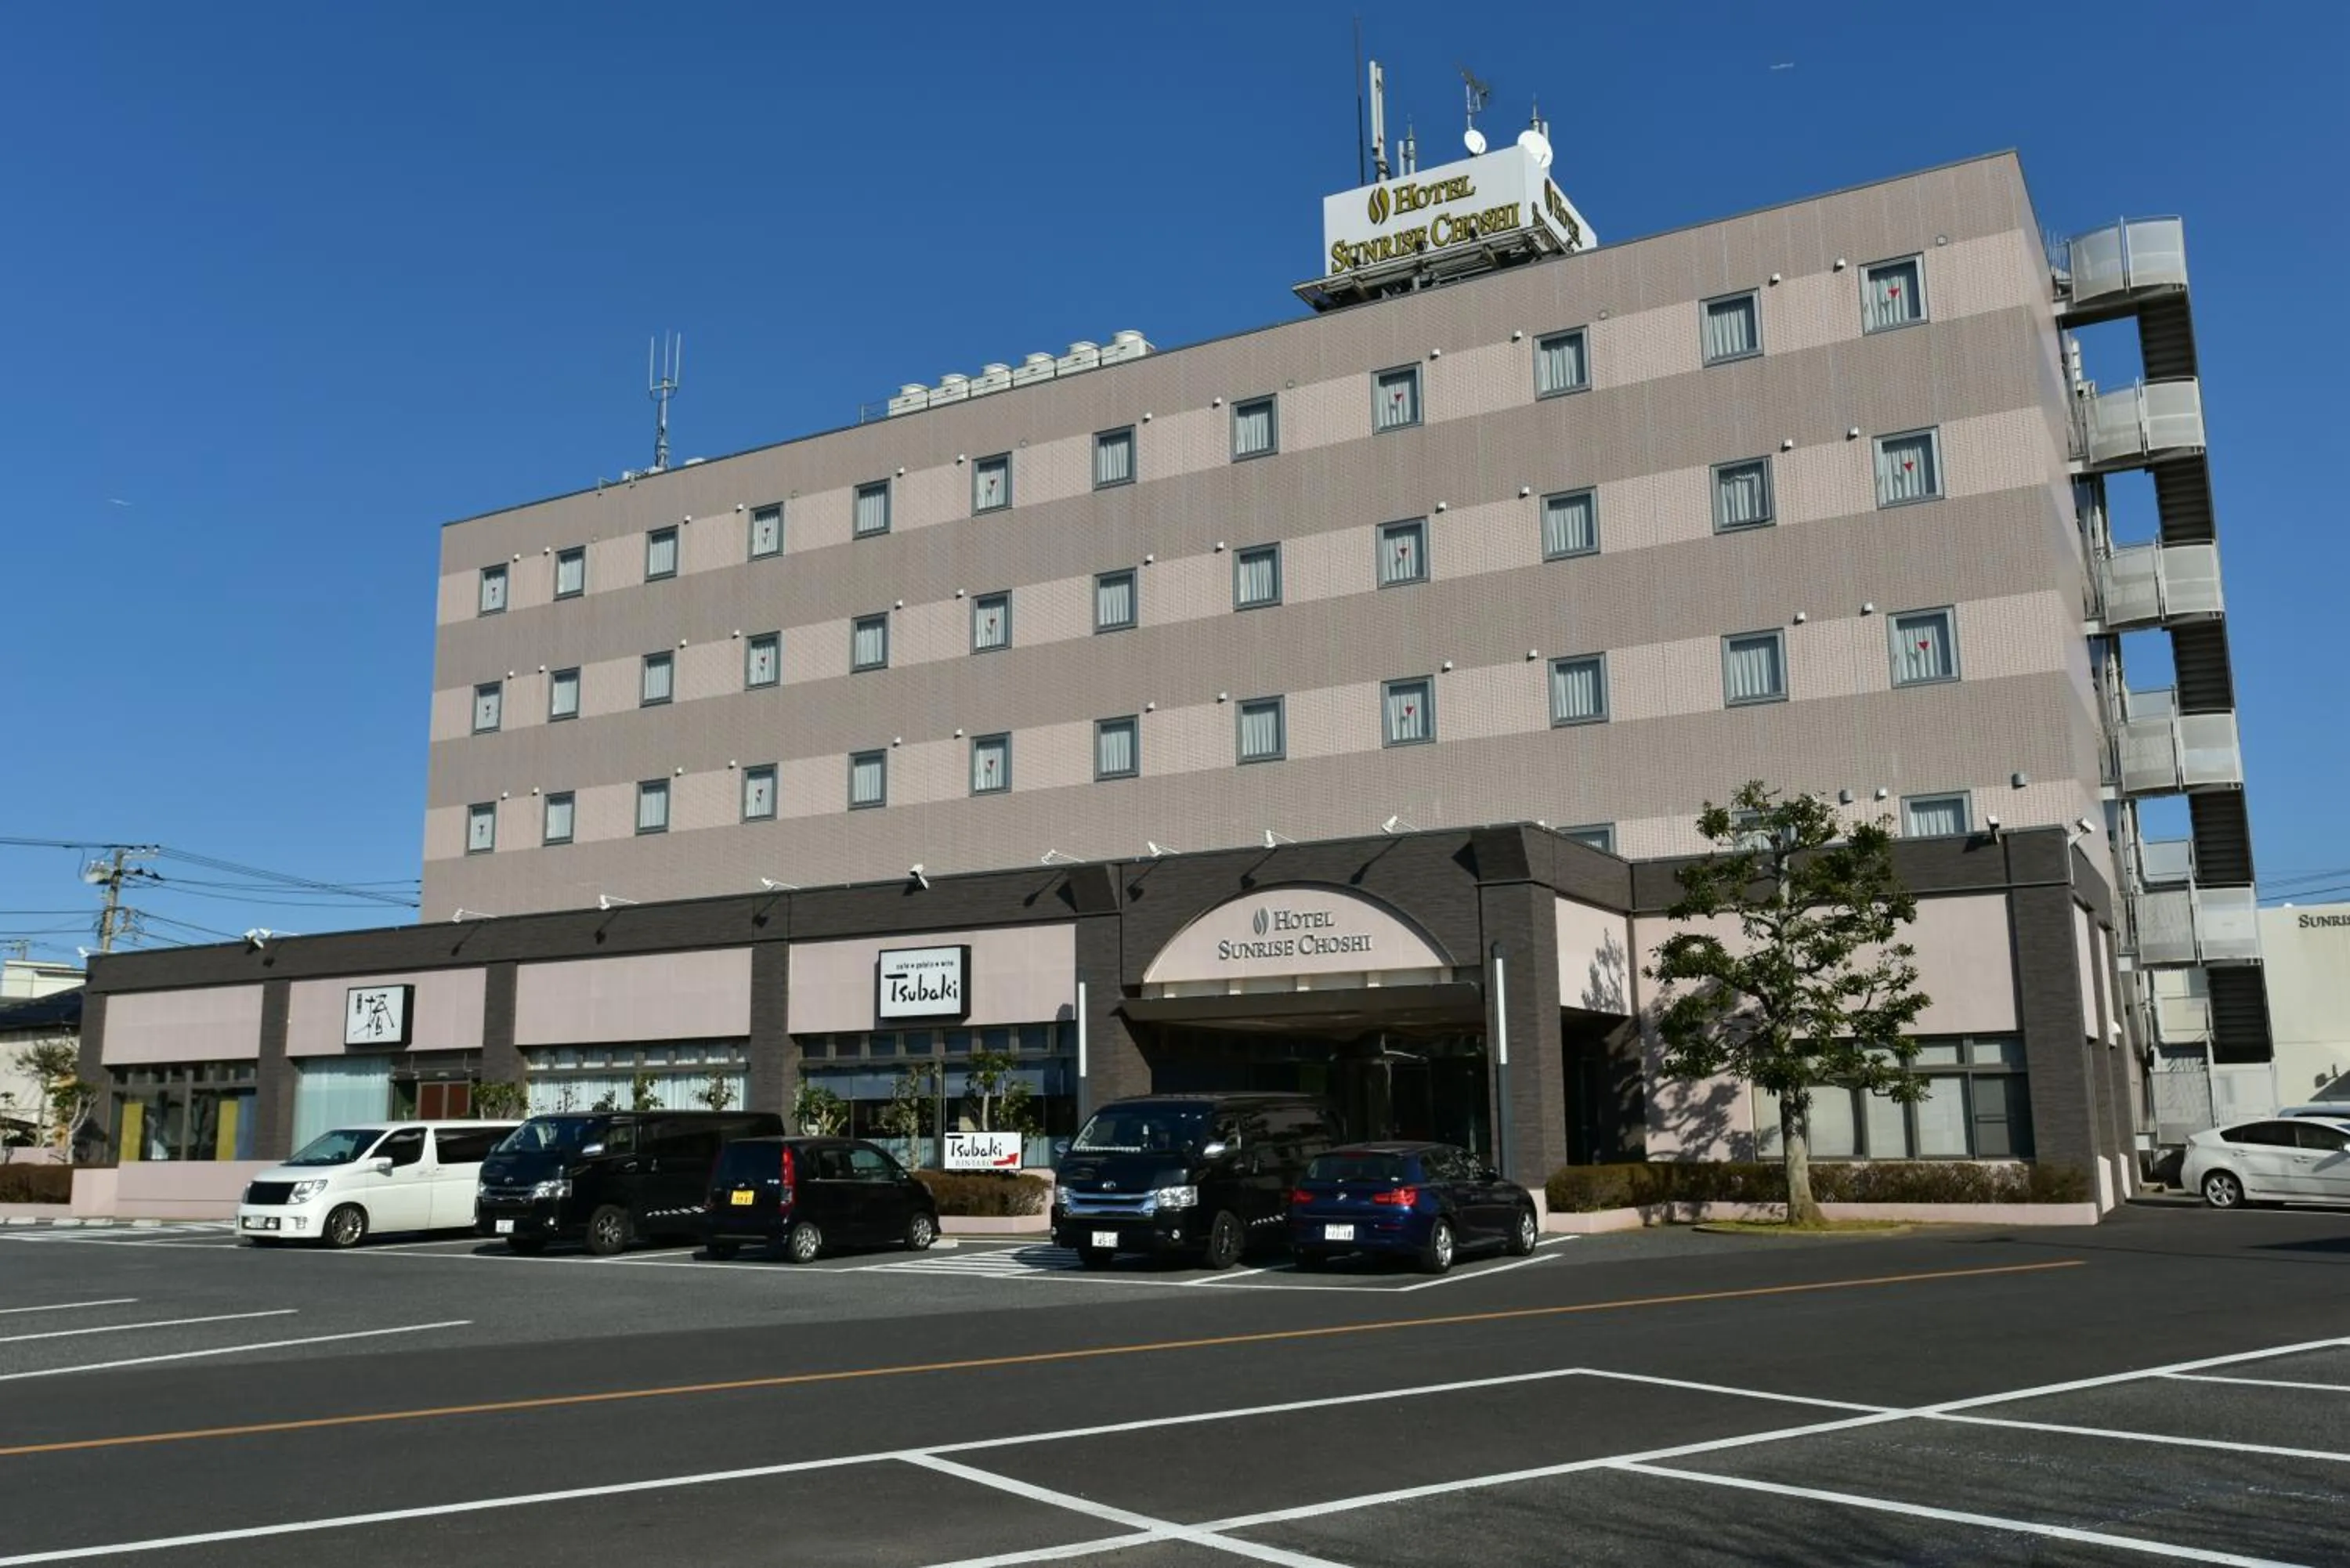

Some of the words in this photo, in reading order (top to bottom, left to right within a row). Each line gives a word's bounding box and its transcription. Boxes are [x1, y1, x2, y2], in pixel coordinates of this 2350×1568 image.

[1393, 175, 1476, 215] HOTEL
[1332, 226, 1427, 273] SUNRISE
[1430, 201, 1520, 247] CHOSHI
[1274, 910, 1335, 930] HOTEL
[1218, 939, 1294, 960] SUNRISE
[1298, 934, 1372, 955] CHOSHI
[884, 973, 957, 1003] Tsubaki
[946, 1135, 1003, 1158] Tsubaki
